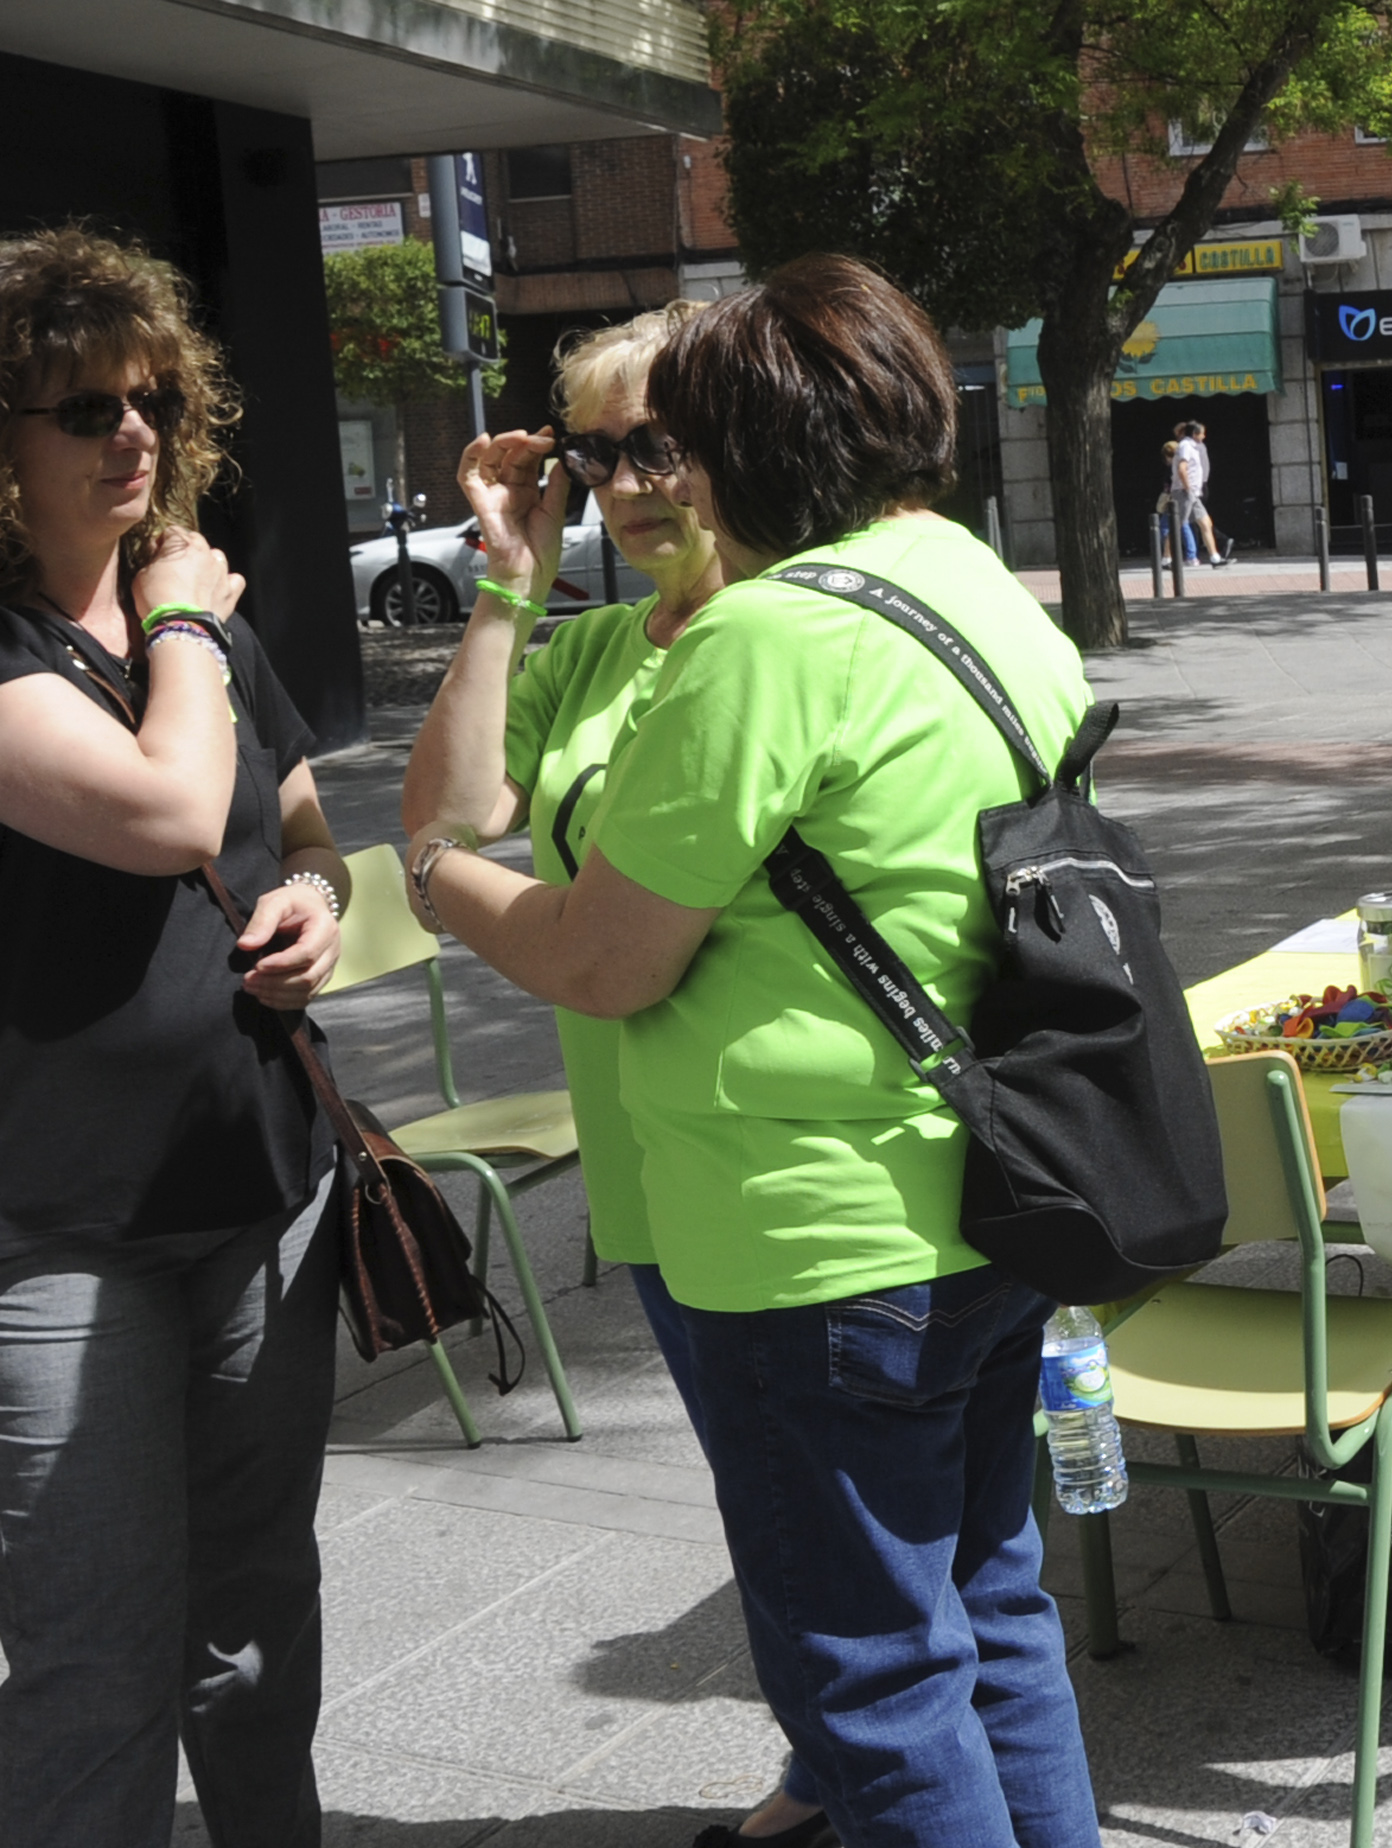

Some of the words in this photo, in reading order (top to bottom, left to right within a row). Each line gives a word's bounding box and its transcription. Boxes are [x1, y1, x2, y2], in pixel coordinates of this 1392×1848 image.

[1151, 373, 1258, 395] CASTILLA
[884, 595, 938, 632] journey
[937, 632, 954, 646] of
[951, 646, 961, 655] a
[960, 653, 1004, 705] thousand
[1002, 704, 1025, 736] miles
[811, 893, 847, 933] single
[852, 944, 880, 975] with
[877, 974, 917, 1020] begins
